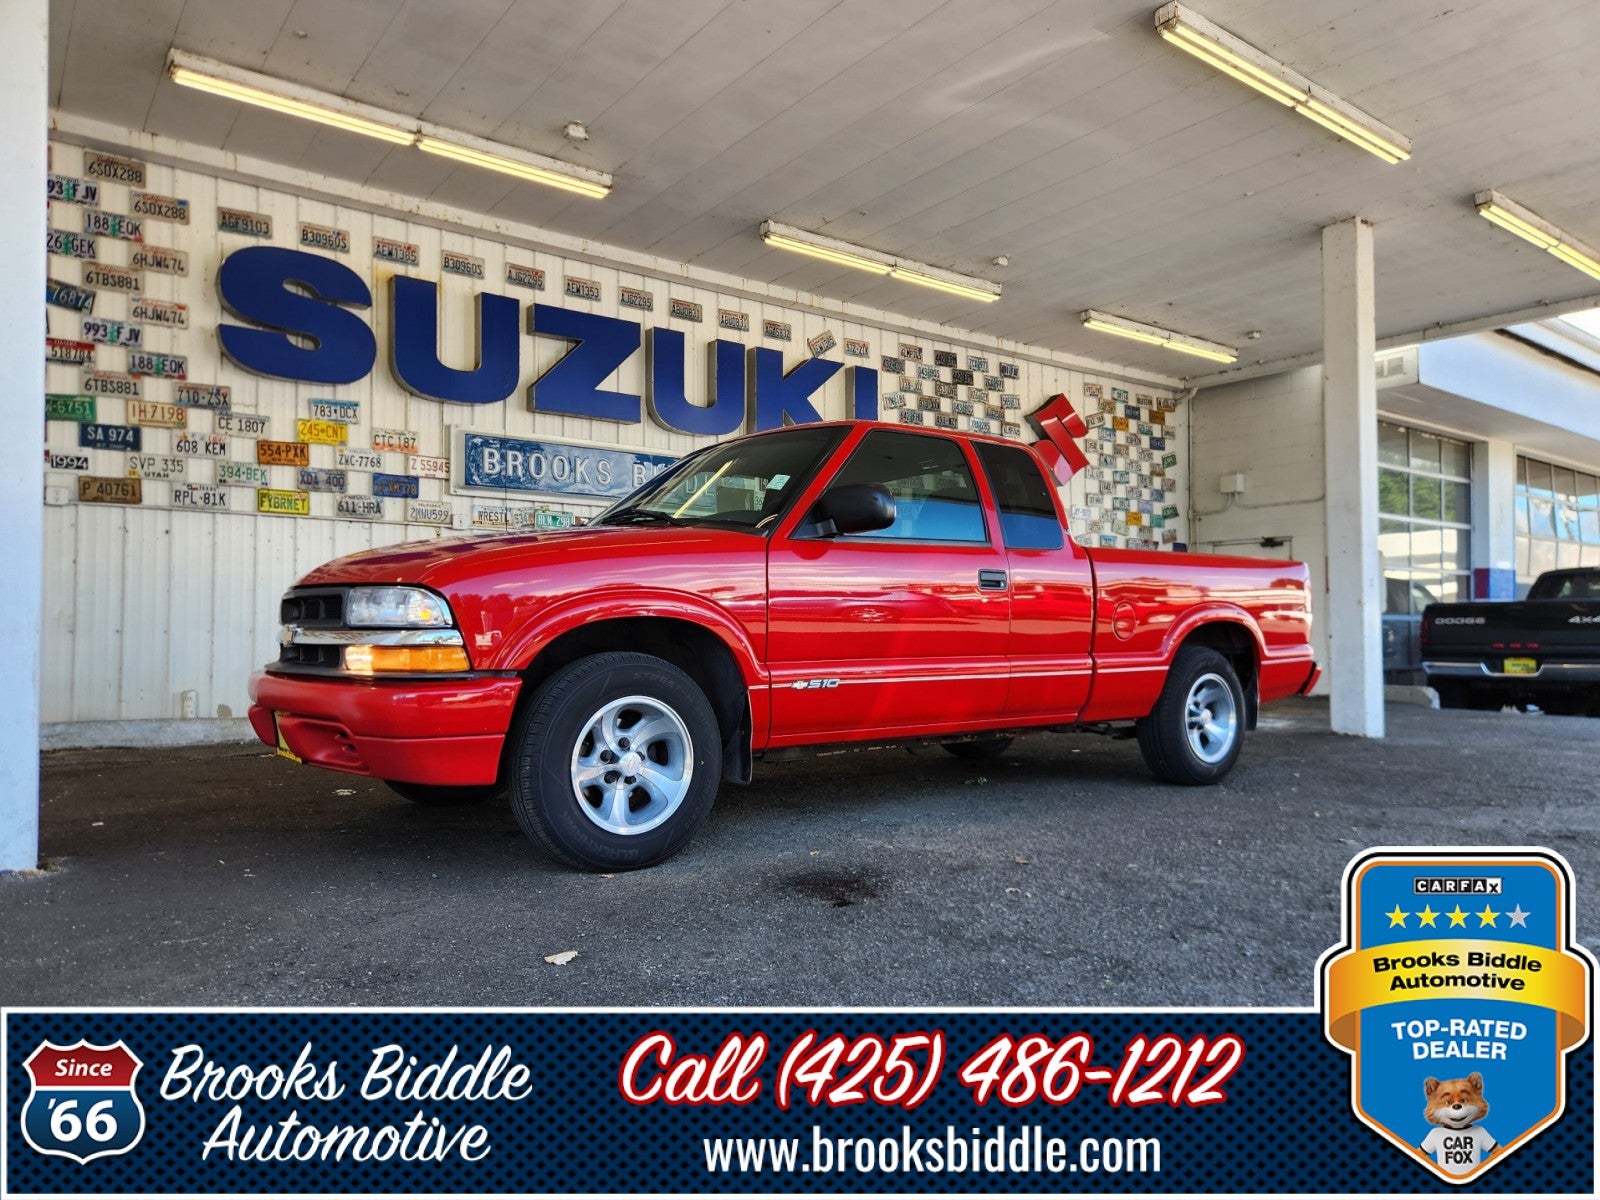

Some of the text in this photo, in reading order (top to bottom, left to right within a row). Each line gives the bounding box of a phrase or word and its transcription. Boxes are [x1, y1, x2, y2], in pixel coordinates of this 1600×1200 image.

[47, 179, 63, 193] 93
[86, 214, 109, 230] 188
[47, 233, 96, 255] 26 GEK
[132, 252, 184, 272] 6HJW474
[85, 271, 140, 291] 6TBS881
[132, 305, 184, 325] 6HJW474
[84, 321, 107, 338] 993
[217, 246, 878, 435] SUZUKI
[131, 355, 153, 371] 188
[84, 378, 140, 395] 6TBS881
[218, 417, 233, 430] CE
[238, 419, 265, 434] 1807
[87, 428, 134, 443] SA 974
[176, 440, 226, 456] 608 KEM
[51, 455, 88, 469] 1994
[129, 456, 184, 473] SVP 335
[482, 448, 613, 485] BROOKS
[96, 482, 136, 496] 40761
[1435, 617, 1485, 625] DODGE
[807, 678, 840, 689] S10
